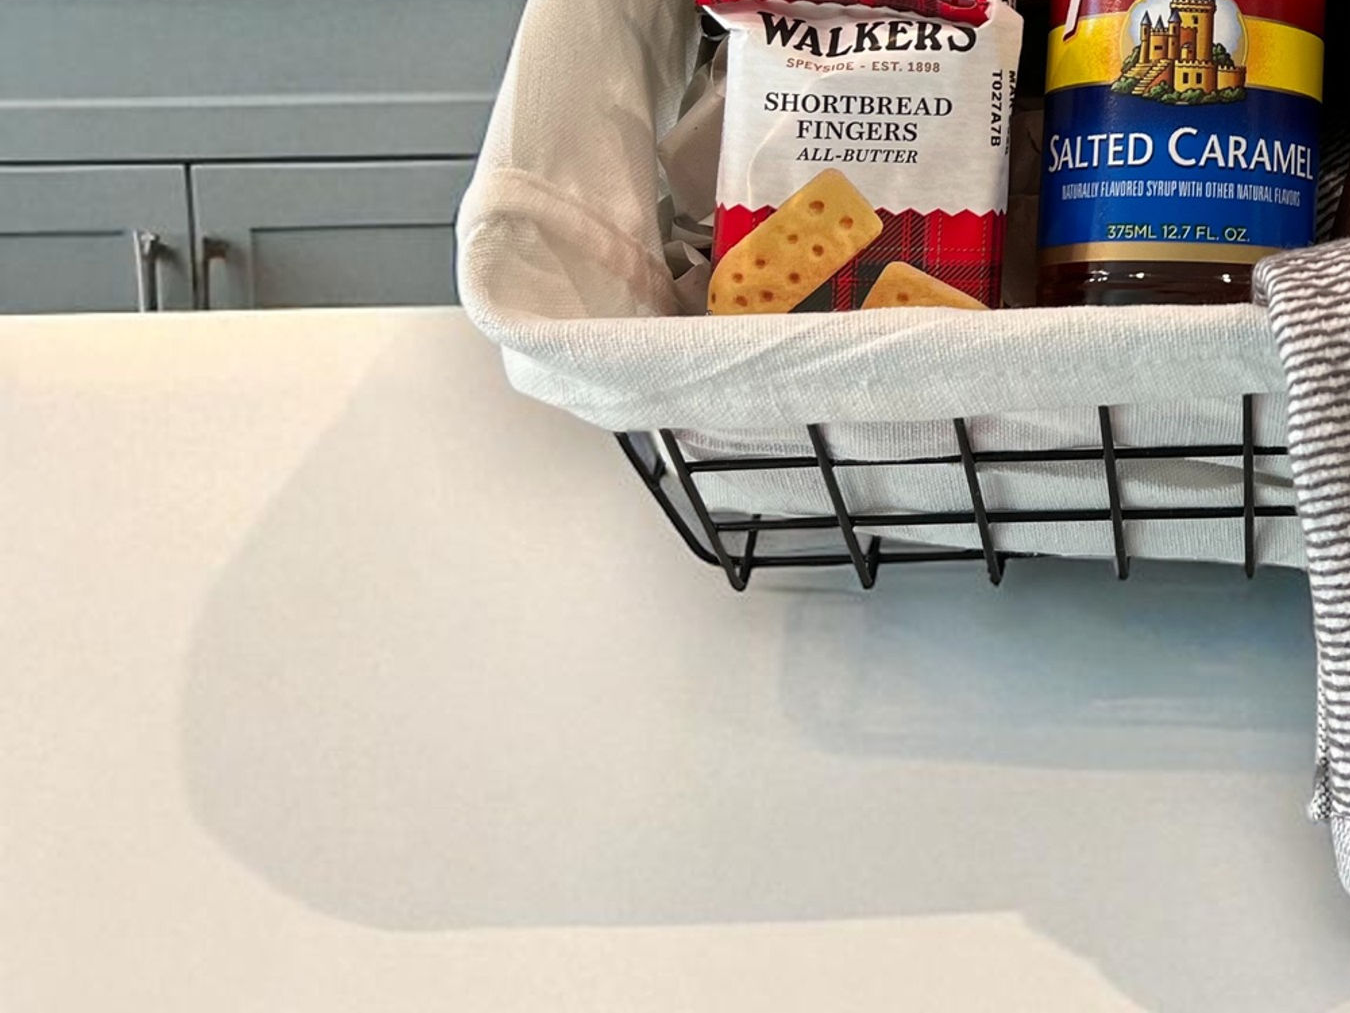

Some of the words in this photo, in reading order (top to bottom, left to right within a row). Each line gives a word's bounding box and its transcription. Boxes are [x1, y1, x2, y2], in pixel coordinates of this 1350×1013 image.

[757, 11, 977, 58] WALKERS
[786, 58, 854, 73] SPEYSIDE
[872, 61, 903, 73] EST.
[907, 62, 941, 73] 1898
[764, 92, 953, 117] SHORTBREAD
[990, 70, 1003, 148] T027A7B
[796, 120, 918, 142] FINGERS
[796, 146, 918, 164] ALL-BUTTER
[1048, 133, 1153, 173] SALTED
[1167, 127, 1313, 180] CARAMEL
[1062, 181, 1099, 201] NATURALLY
[1100, 179, 1144, 198] FLAVORED
[1146, 179, 1177, 198] SYRUP
[1178, 181, 1203, 198] WITH
[1205, 182, 1235, 199] OTHER
[1236, 183, 1273, 204] NATURAL
[1274, 188, 1300, 207] FLAVORS
[1106, 224, 1157, 239] 375ML
[1162, 224, 1190, 239] 12.7
[1196, 225, 1220, 241] FL.
[1224, 228, 1250, 242] OZ.
